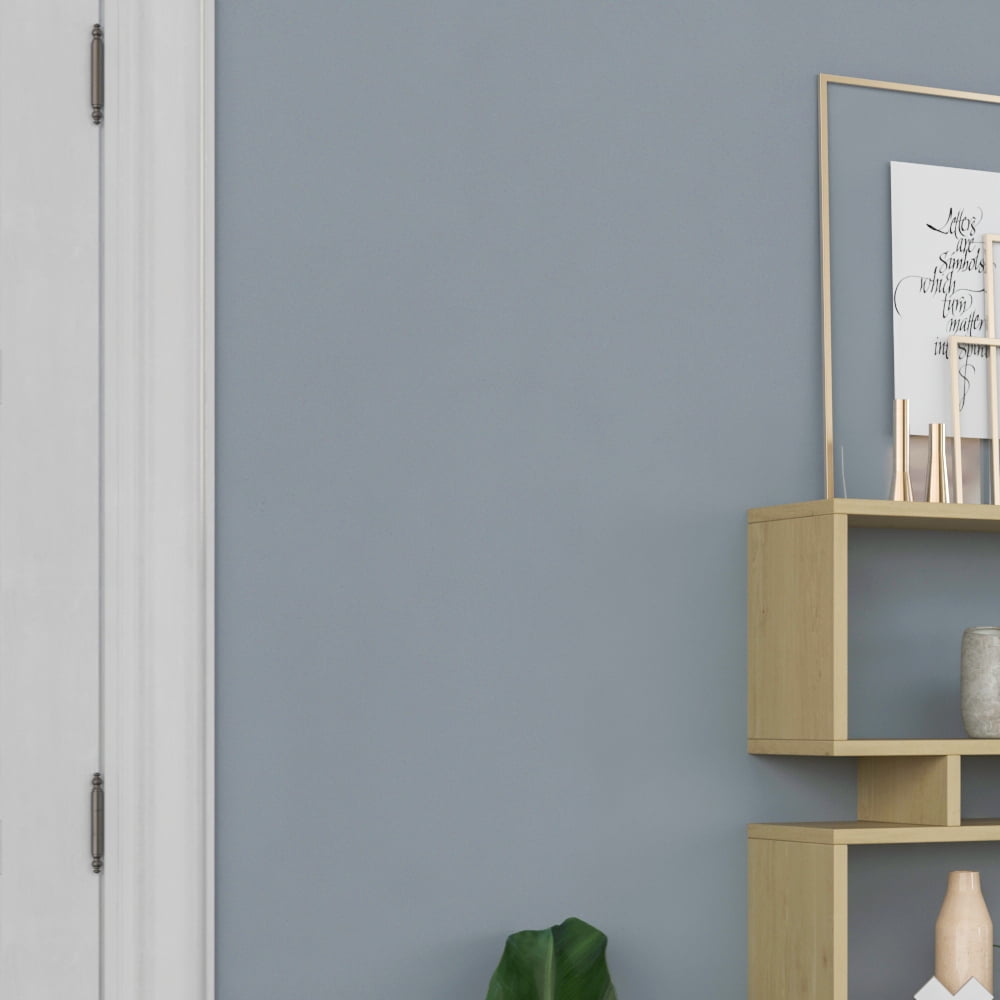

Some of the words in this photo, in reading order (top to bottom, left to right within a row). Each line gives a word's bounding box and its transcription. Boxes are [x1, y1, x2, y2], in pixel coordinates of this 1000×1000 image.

[926, 207, 980, 239] Letters
[955, 237, 976, 254] are
[934, 336, 950, 360] int
